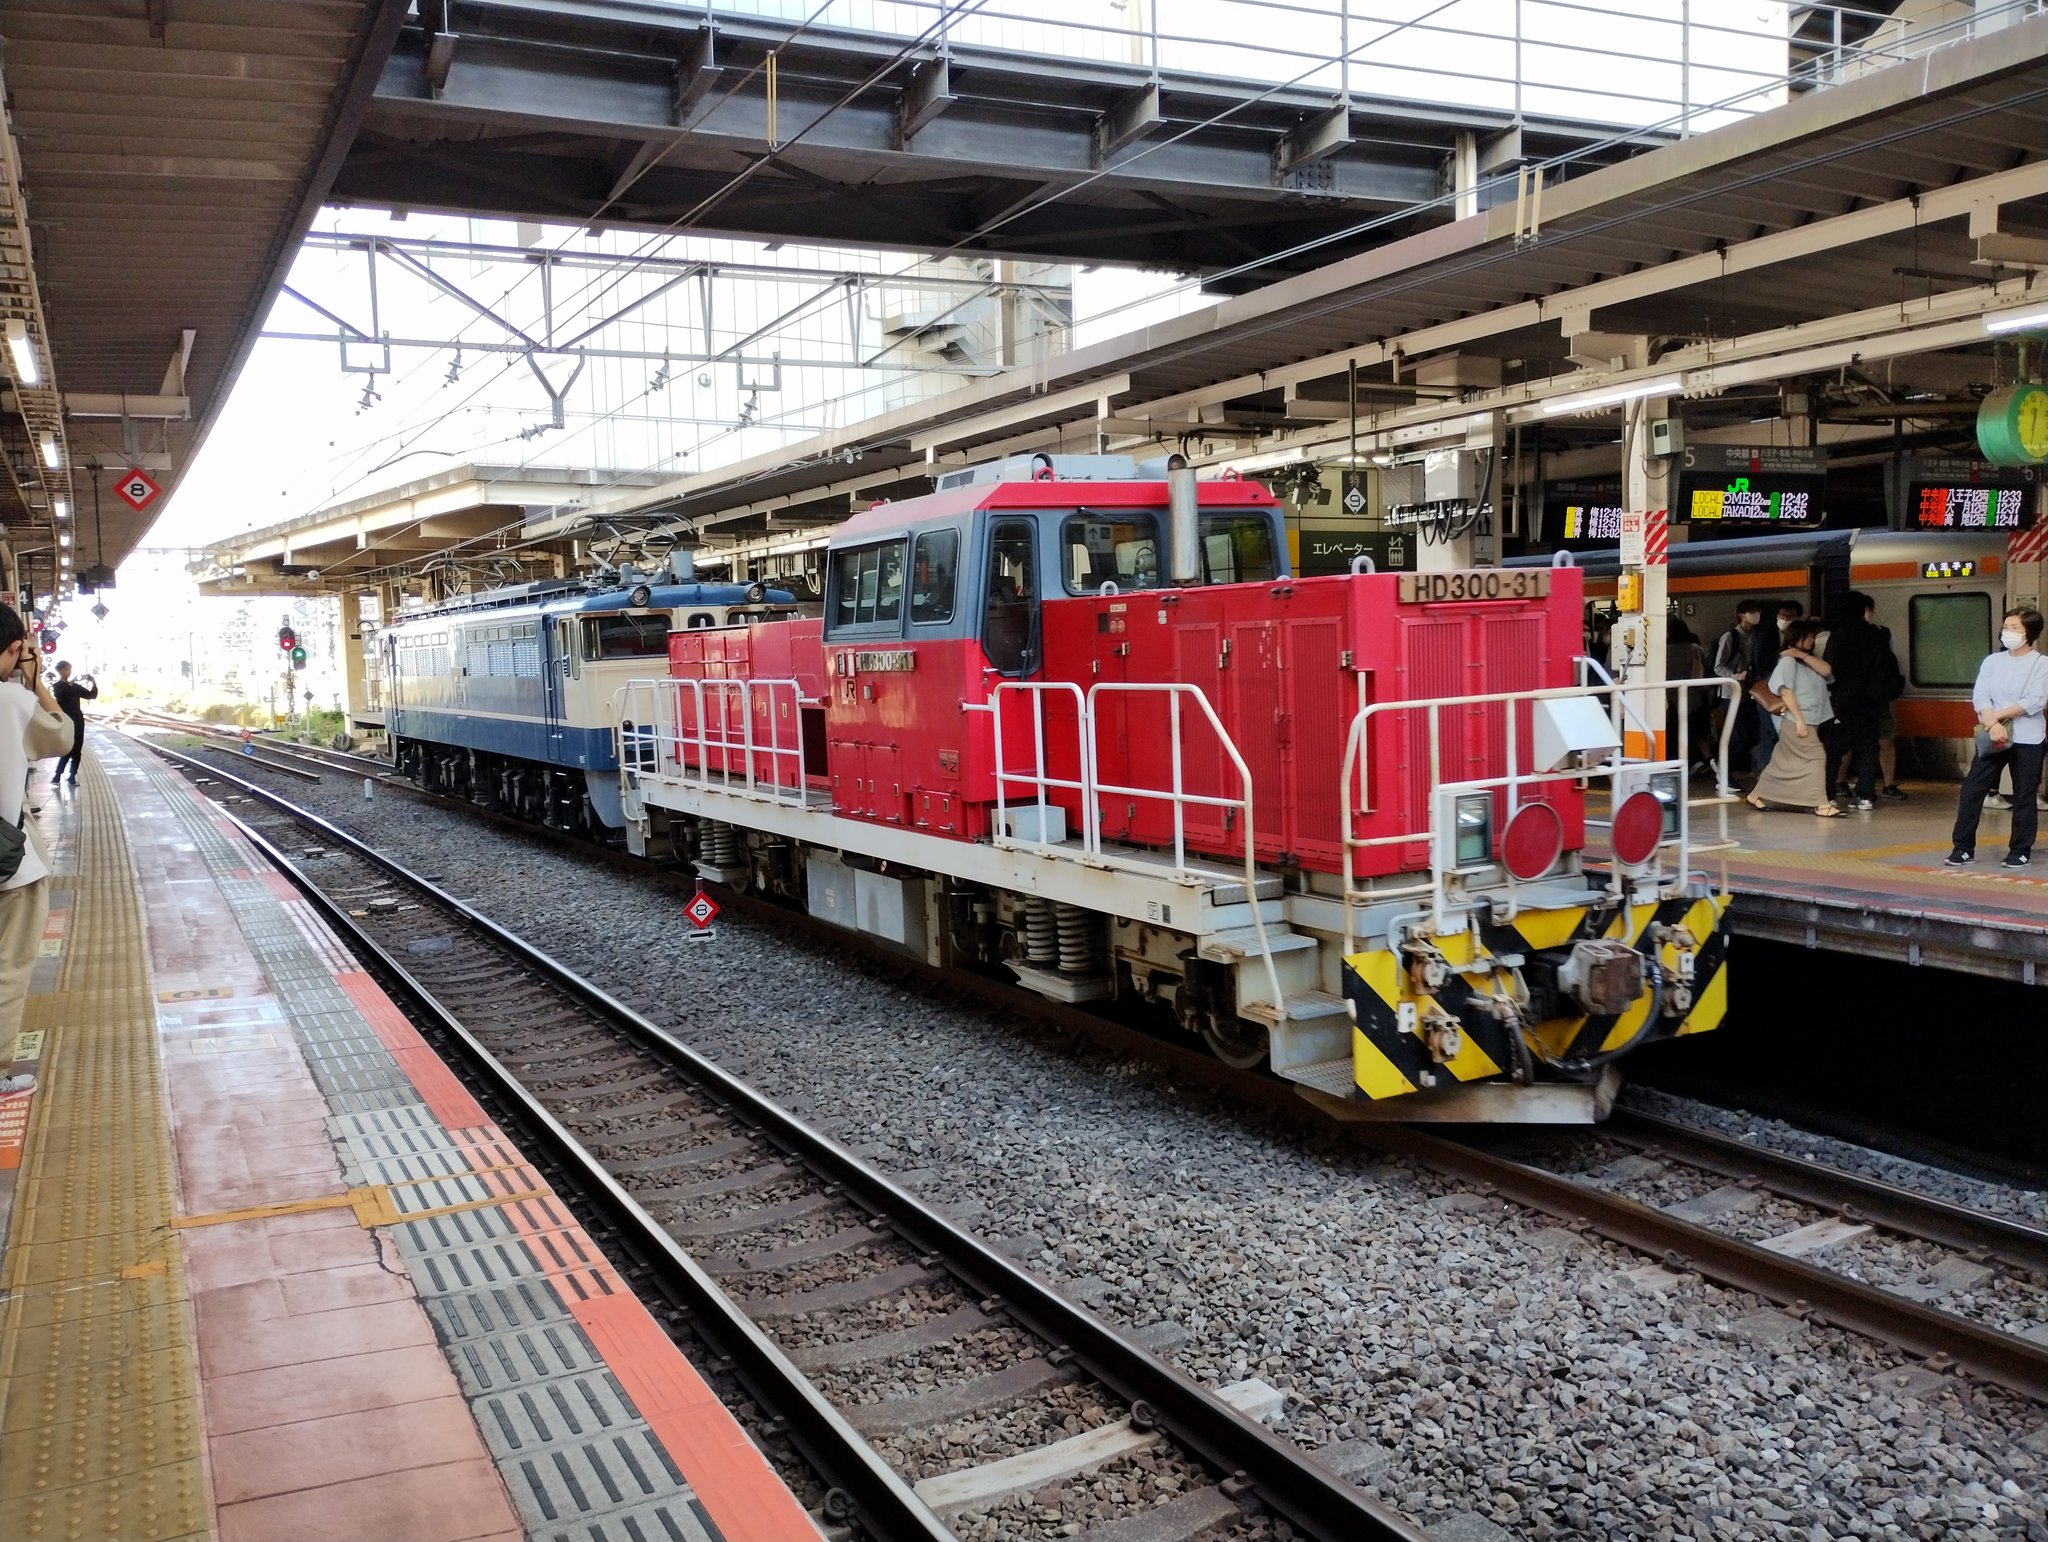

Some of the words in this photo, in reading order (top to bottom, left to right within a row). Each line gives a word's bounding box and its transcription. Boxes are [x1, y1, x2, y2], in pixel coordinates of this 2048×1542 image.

[1684, 446, 1696, 468] 5
[130, 483, 146, 497] 8
[1727, 477, 1750, 493] JR
[1350, 494, 1361, 507] 9
[1693, 491, 1722, 505] LOCAL
[1780, 492, 1809, 506] 12:42
[1948, 489, 1973, 503] 八王子
[1998, 490, 2022, 503] 12:33
[1599, 508, 1623, 518] 12:42
[1691, 505, 1720, 518] LOCAL
[1722, 505, 1749, 518] TAKAO
[1779, 505, 1807, 519] 12:55
[1996, 502, 2021, 514] 12:37
[1598, 518, 1621, 528] 12:51
[1994, 514, 2019, 527] 12:44
[1596, 528, 1621, 539] 13:02
[1312, 543, 1374, 555] エレベーター
[1414, 571, 1541, 602] HD300-31
[1686, 603, 1694, 615] 3
[287, 714, 300, 723] 45
[695, 903, 708, 916] 8
